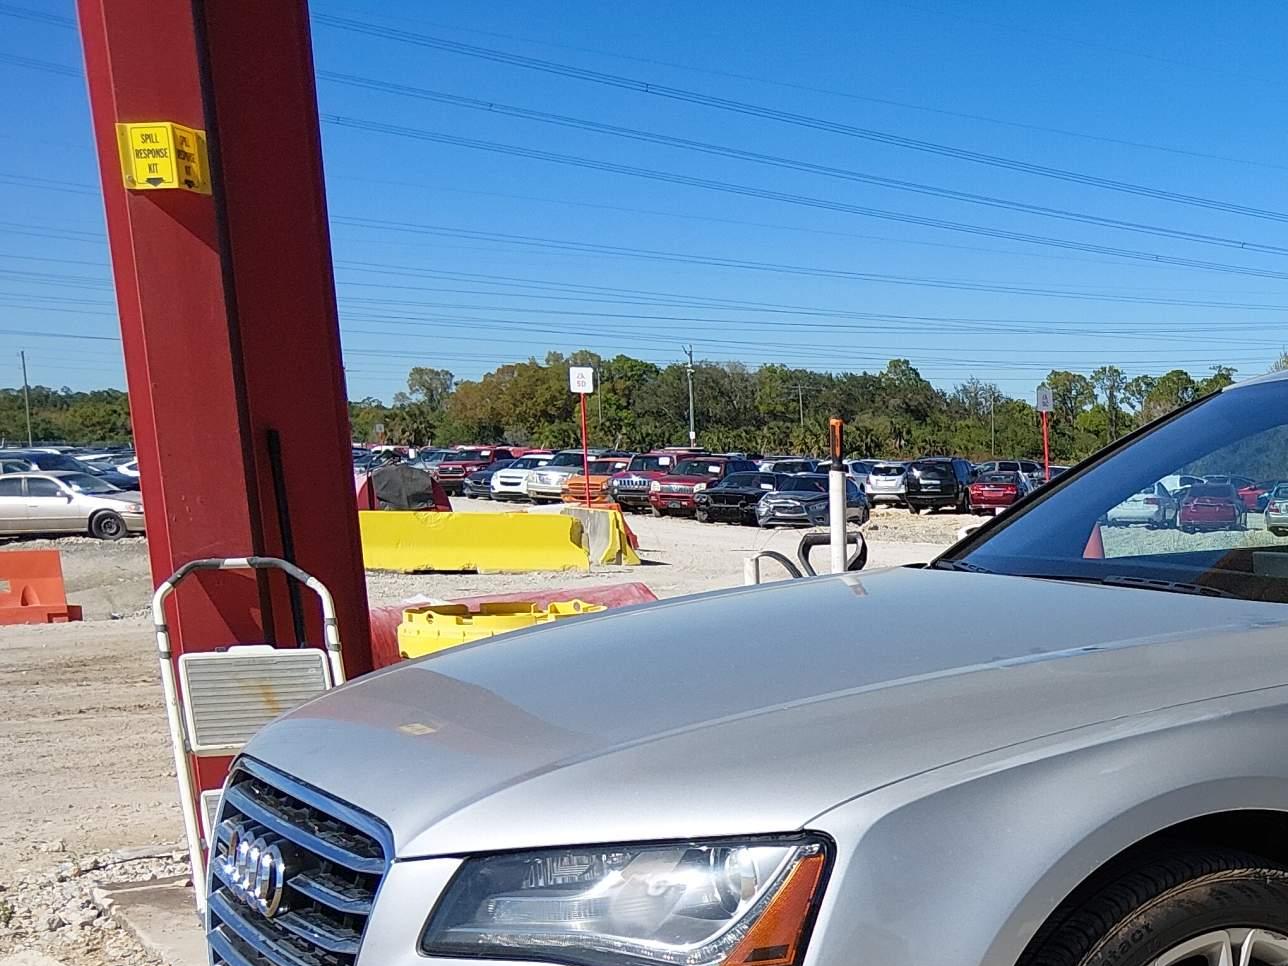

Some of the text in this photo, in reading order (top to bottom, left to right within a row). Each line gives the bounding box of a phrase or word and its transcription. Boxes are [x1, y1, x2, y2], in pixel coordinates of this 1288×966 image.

[141, 133, 160, 144] SPILL
[135, 148, 168, 159] RESPONSE
[148, 163, 158, 174] KIT
